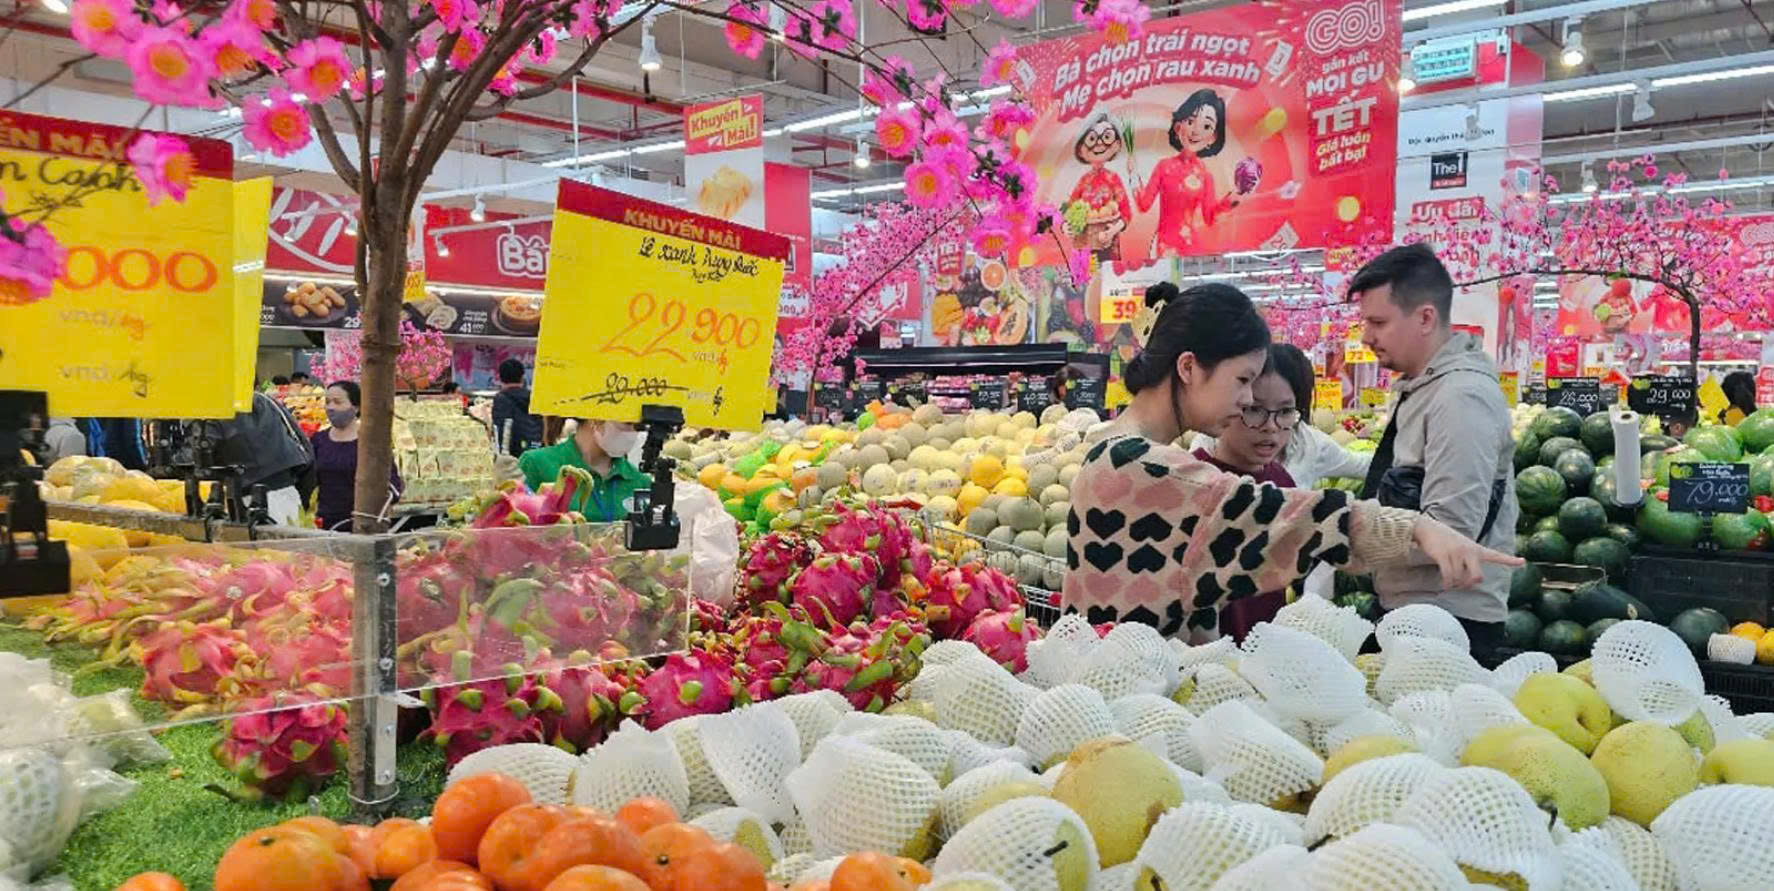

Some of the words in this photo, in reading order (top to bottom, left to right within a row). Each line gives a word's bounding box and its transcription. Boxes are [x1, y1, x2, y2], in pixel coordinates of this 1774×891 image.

[1145, 28, 1189, 54] trái
[1191, 34, 1251, 57] ngọt
[1305, 0, 1385, 54] GO!
[1096, 62, 1151, 97] chọn
[1155, 60, 1195, 79] rau
[1200, 59, 1262, 83] xanh
[1306, 72, 1347, 98] MỌI
[1351, 61, 1385, 87] GU
[691, 110, 738, 133] Khuyến
[1312, 89, 1378, 136] TẾT
[1432, 162, 1457, 175] The
[624, 207, 705, 240] KHUYẾN
[708, 229, 741, 250] MÃI
[1684, 480, 1749, 505] 79.000
